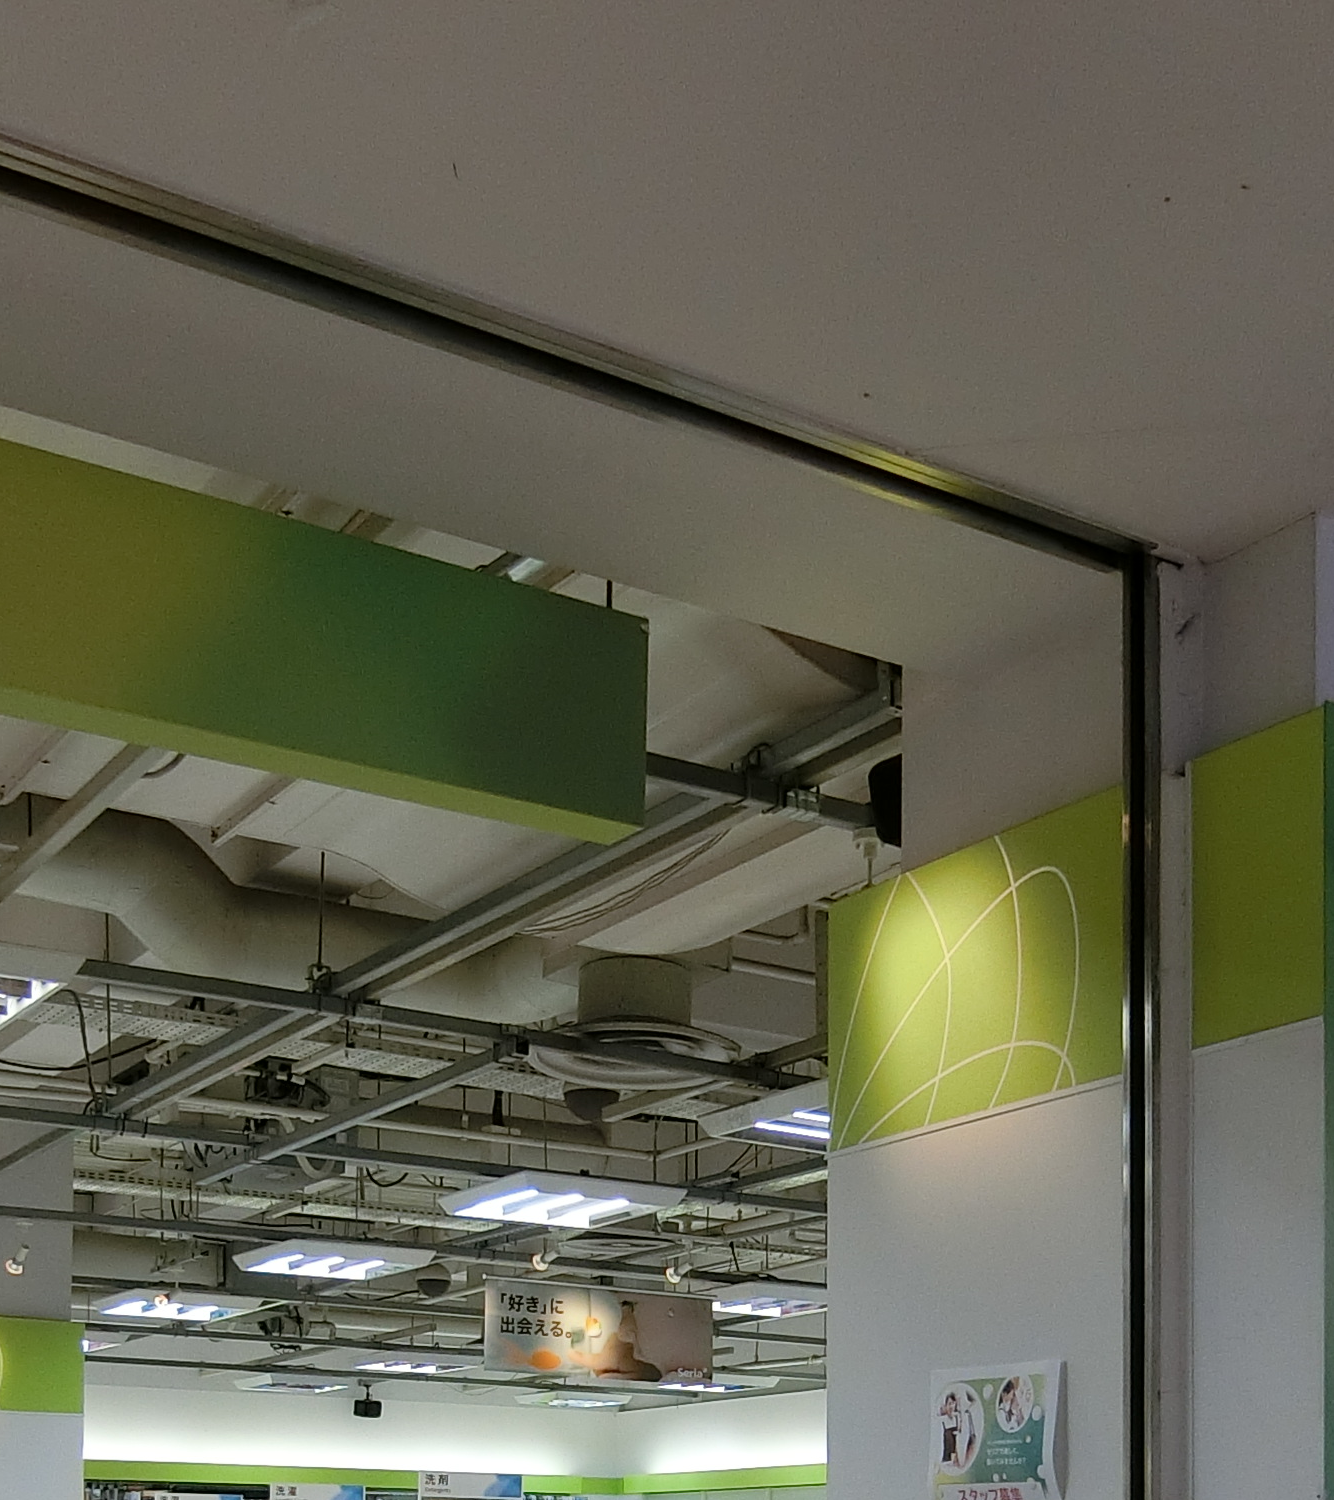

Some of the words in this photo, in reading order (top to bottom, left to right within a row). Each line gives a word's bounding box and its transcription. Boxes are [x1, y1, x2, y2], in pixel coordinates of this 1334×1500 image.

[500, 1292, 564, 1315] 「好き」に
[500, 1316, 572, 1339] 出会える。
[677, 1366, 704, 1379] Seria
[424, 1473, 449, 1486] 洗剤
